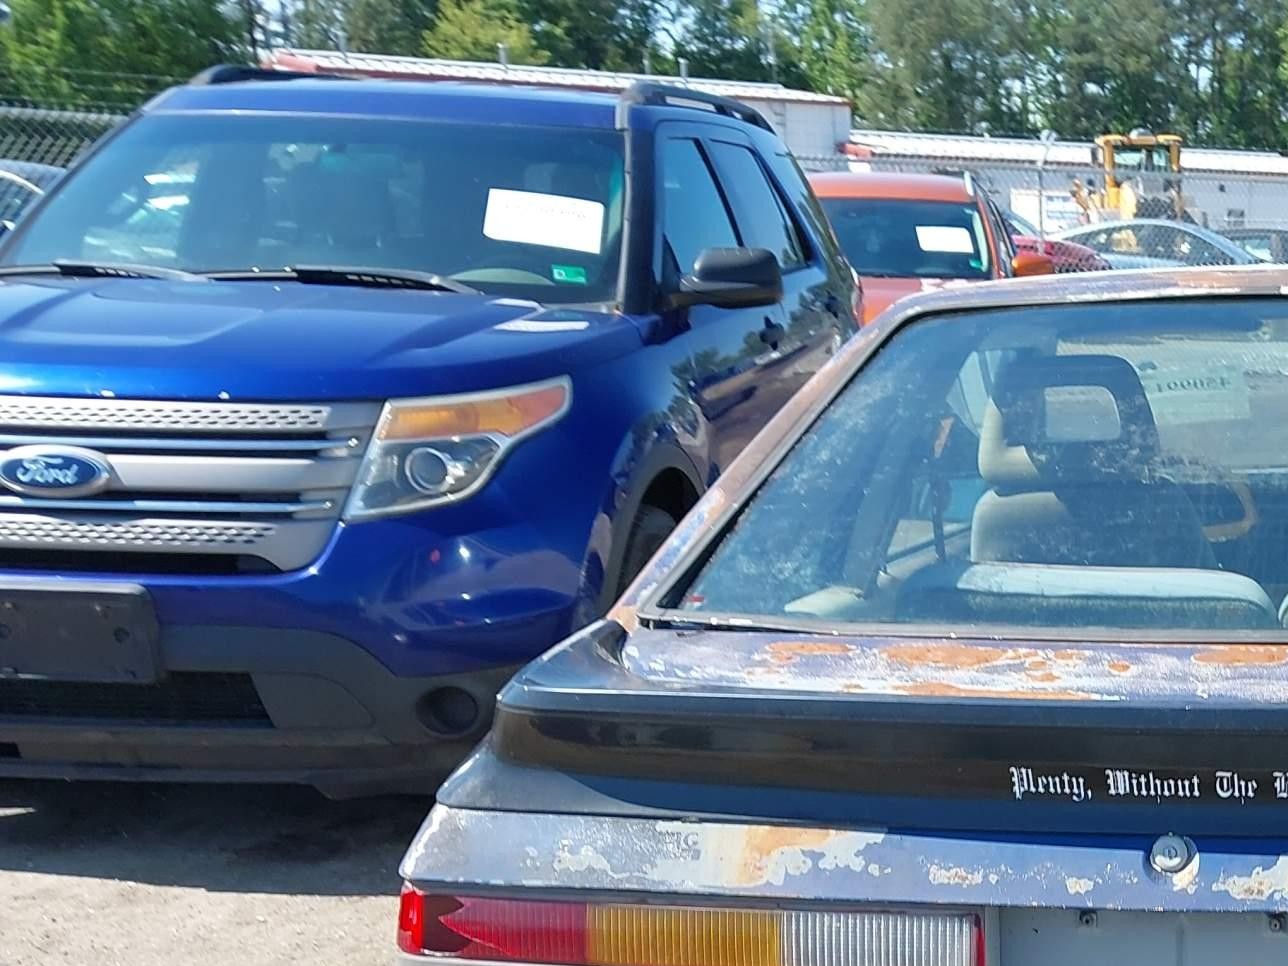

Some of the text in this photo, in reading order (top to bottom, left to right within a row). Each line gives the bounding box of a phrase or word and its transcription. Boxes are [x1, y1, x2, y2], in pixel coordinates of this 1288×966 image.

[16, 457, 79, 484] Ford
[1009, 766, 1092, 802] Plenty,
[1105, 768, 1200, 804] Without
[1215, 770, 1257, 805] The
